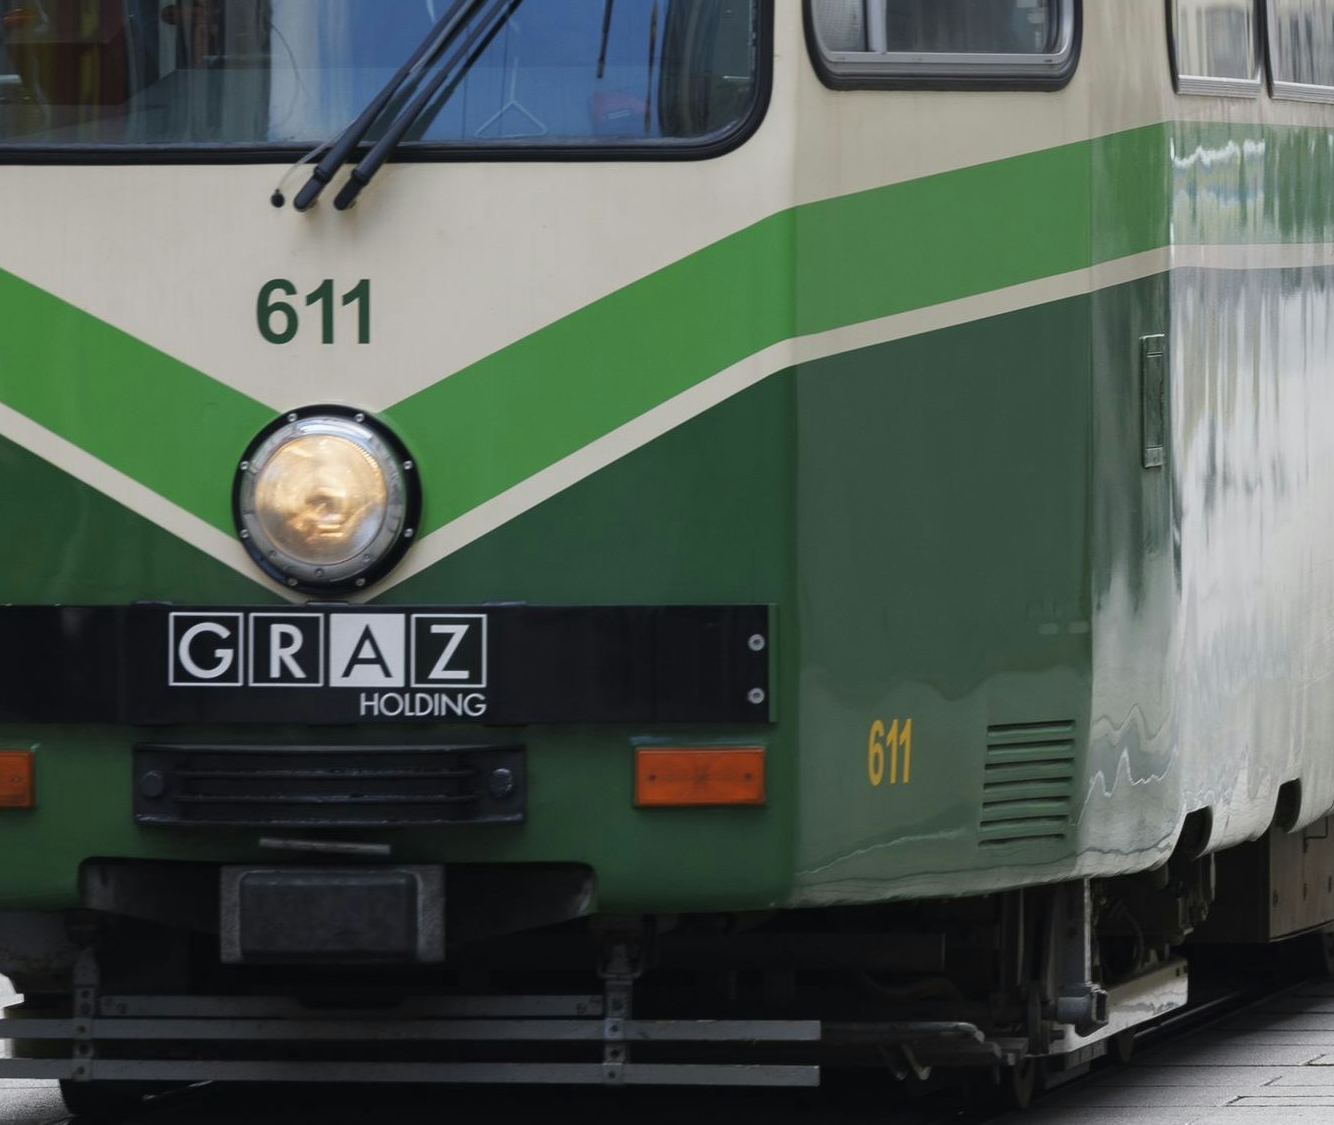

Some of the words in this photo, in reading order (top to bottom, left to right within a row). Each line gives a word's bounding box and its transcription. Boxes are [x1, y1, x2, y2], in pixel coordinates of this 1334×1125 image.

[256, 278, 371, 345] 611
[177, 621, 473, 680] GRAZ
[359, 692, 487, 718] HOLDING
[868, 717, 913, 786] 611
